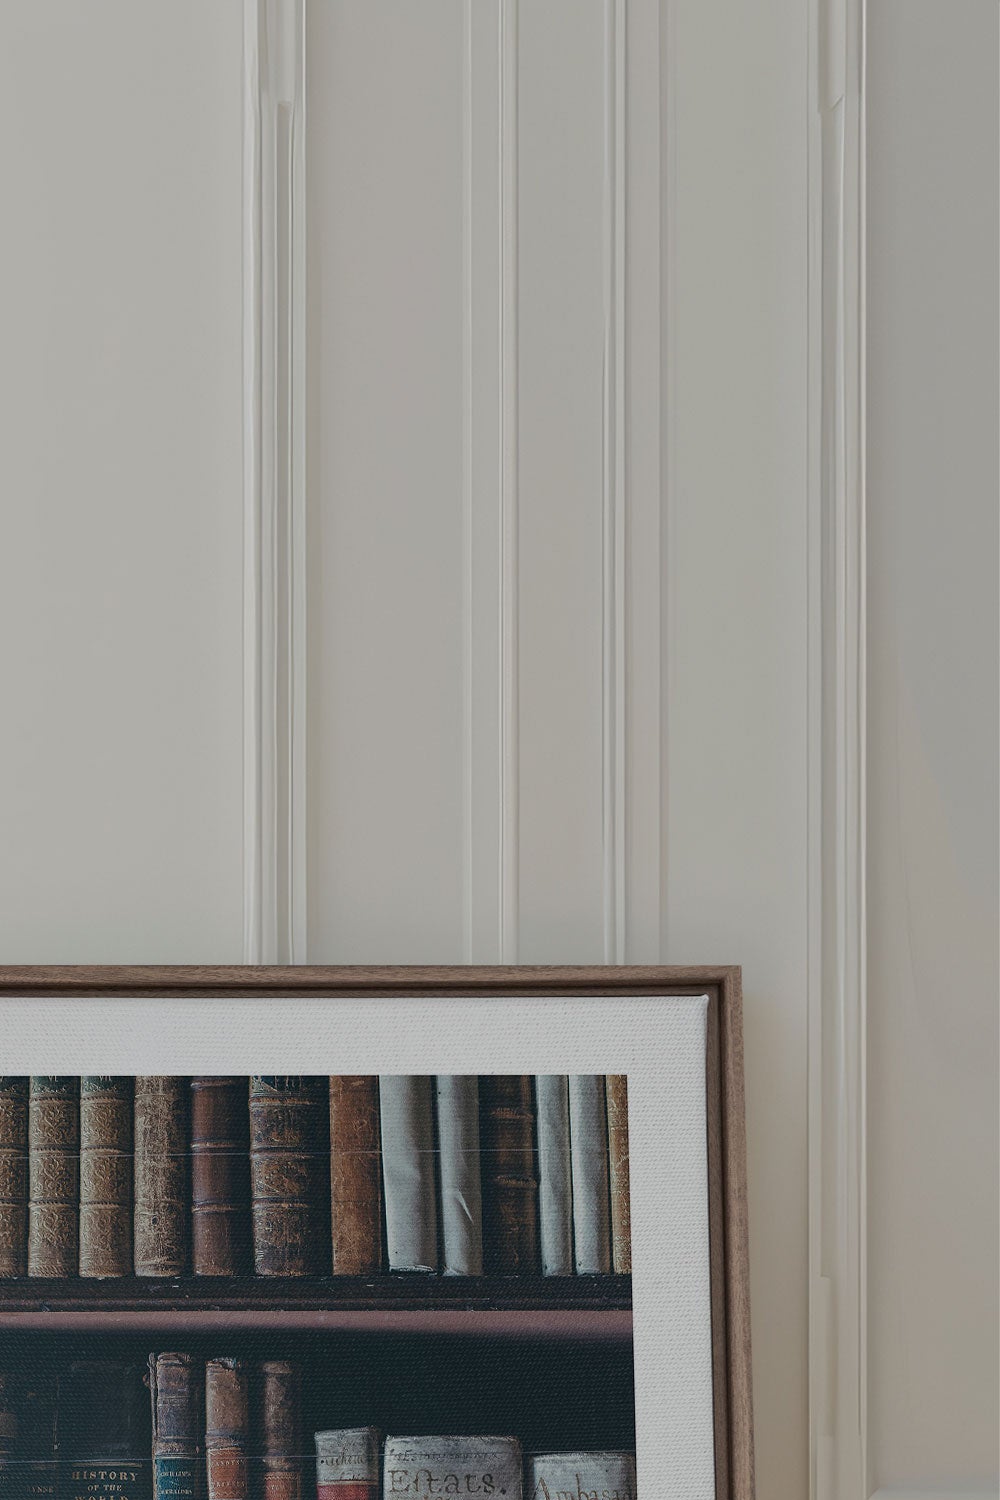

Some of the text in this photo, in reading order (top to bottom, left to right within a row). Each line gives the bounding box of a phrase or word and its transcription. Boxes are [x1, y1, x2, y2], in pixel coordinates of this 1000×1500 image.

[72, 1471, 138, 1481] HISTORY
[87, 1484, 122, 1492] OF THE
